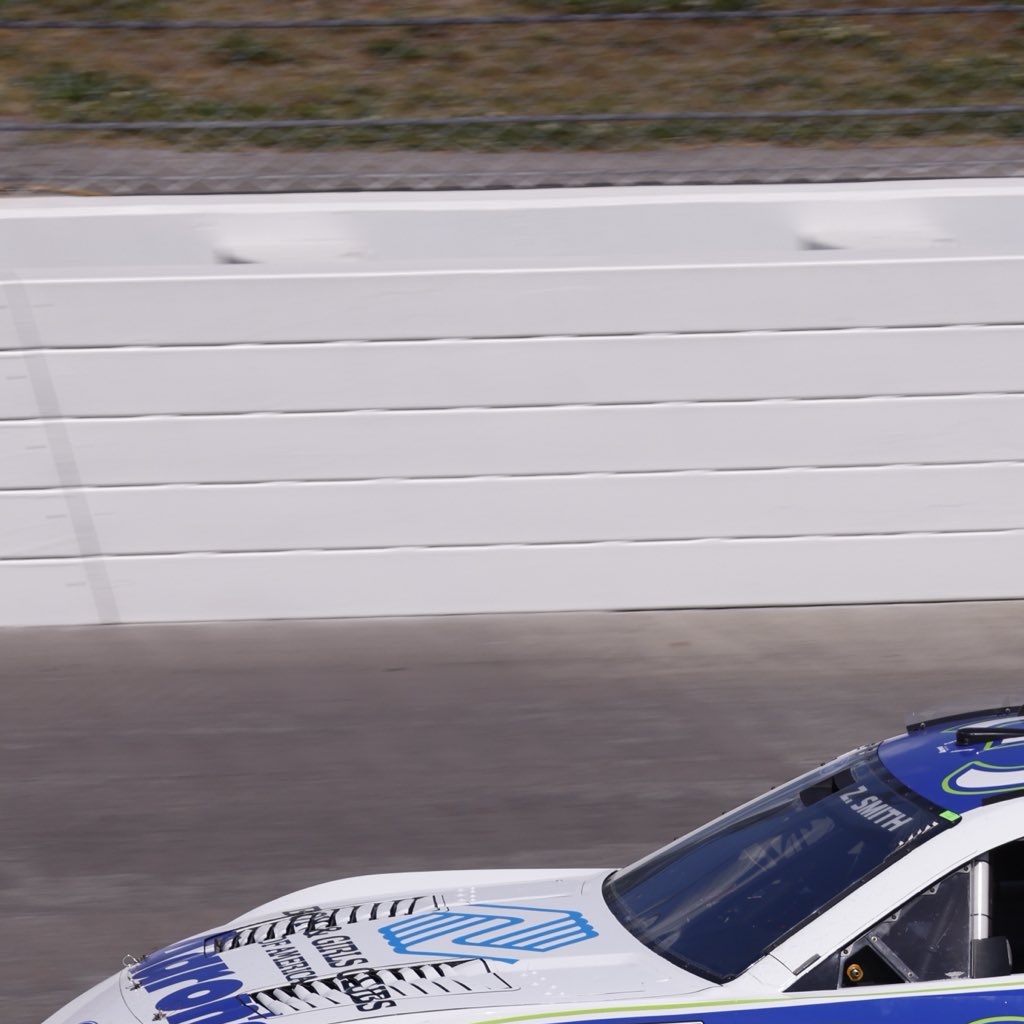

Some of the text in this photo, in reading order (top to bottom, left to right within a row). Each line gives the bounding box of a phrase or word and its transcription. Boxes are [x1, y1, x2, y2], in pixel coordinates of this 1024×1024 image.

[850, 796, 913, 832] SMITH
[266, 946, 320, 987] AMERICA
[312, 936, 368, 968] GIRLS
